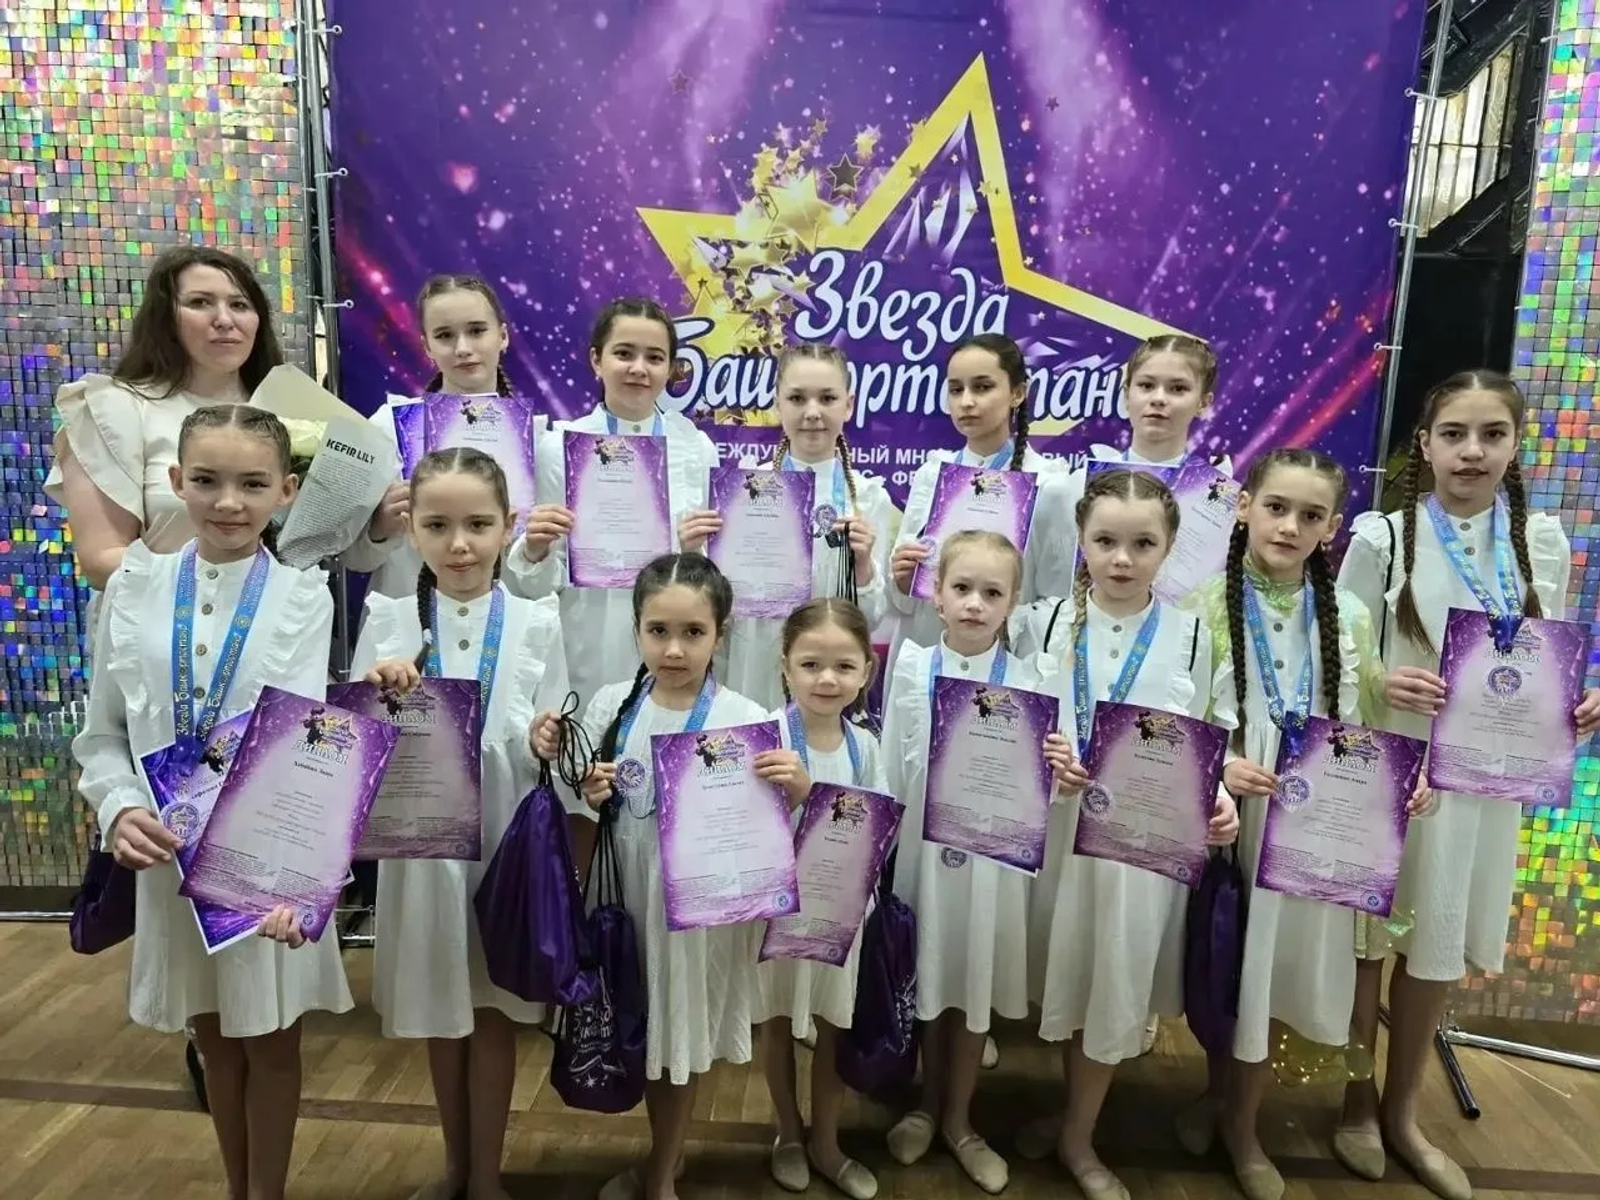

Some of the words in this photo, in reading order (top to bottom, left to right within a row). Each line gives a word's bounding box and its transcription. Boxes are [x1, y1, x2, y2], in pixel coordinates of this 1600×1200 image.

[795, 250, 1010, 362] Звезда
[661, 317, 1130, 429] Башрттан
[326, 438, 357, 458] KEFIR
[357, 449, 376, 465] LILY
